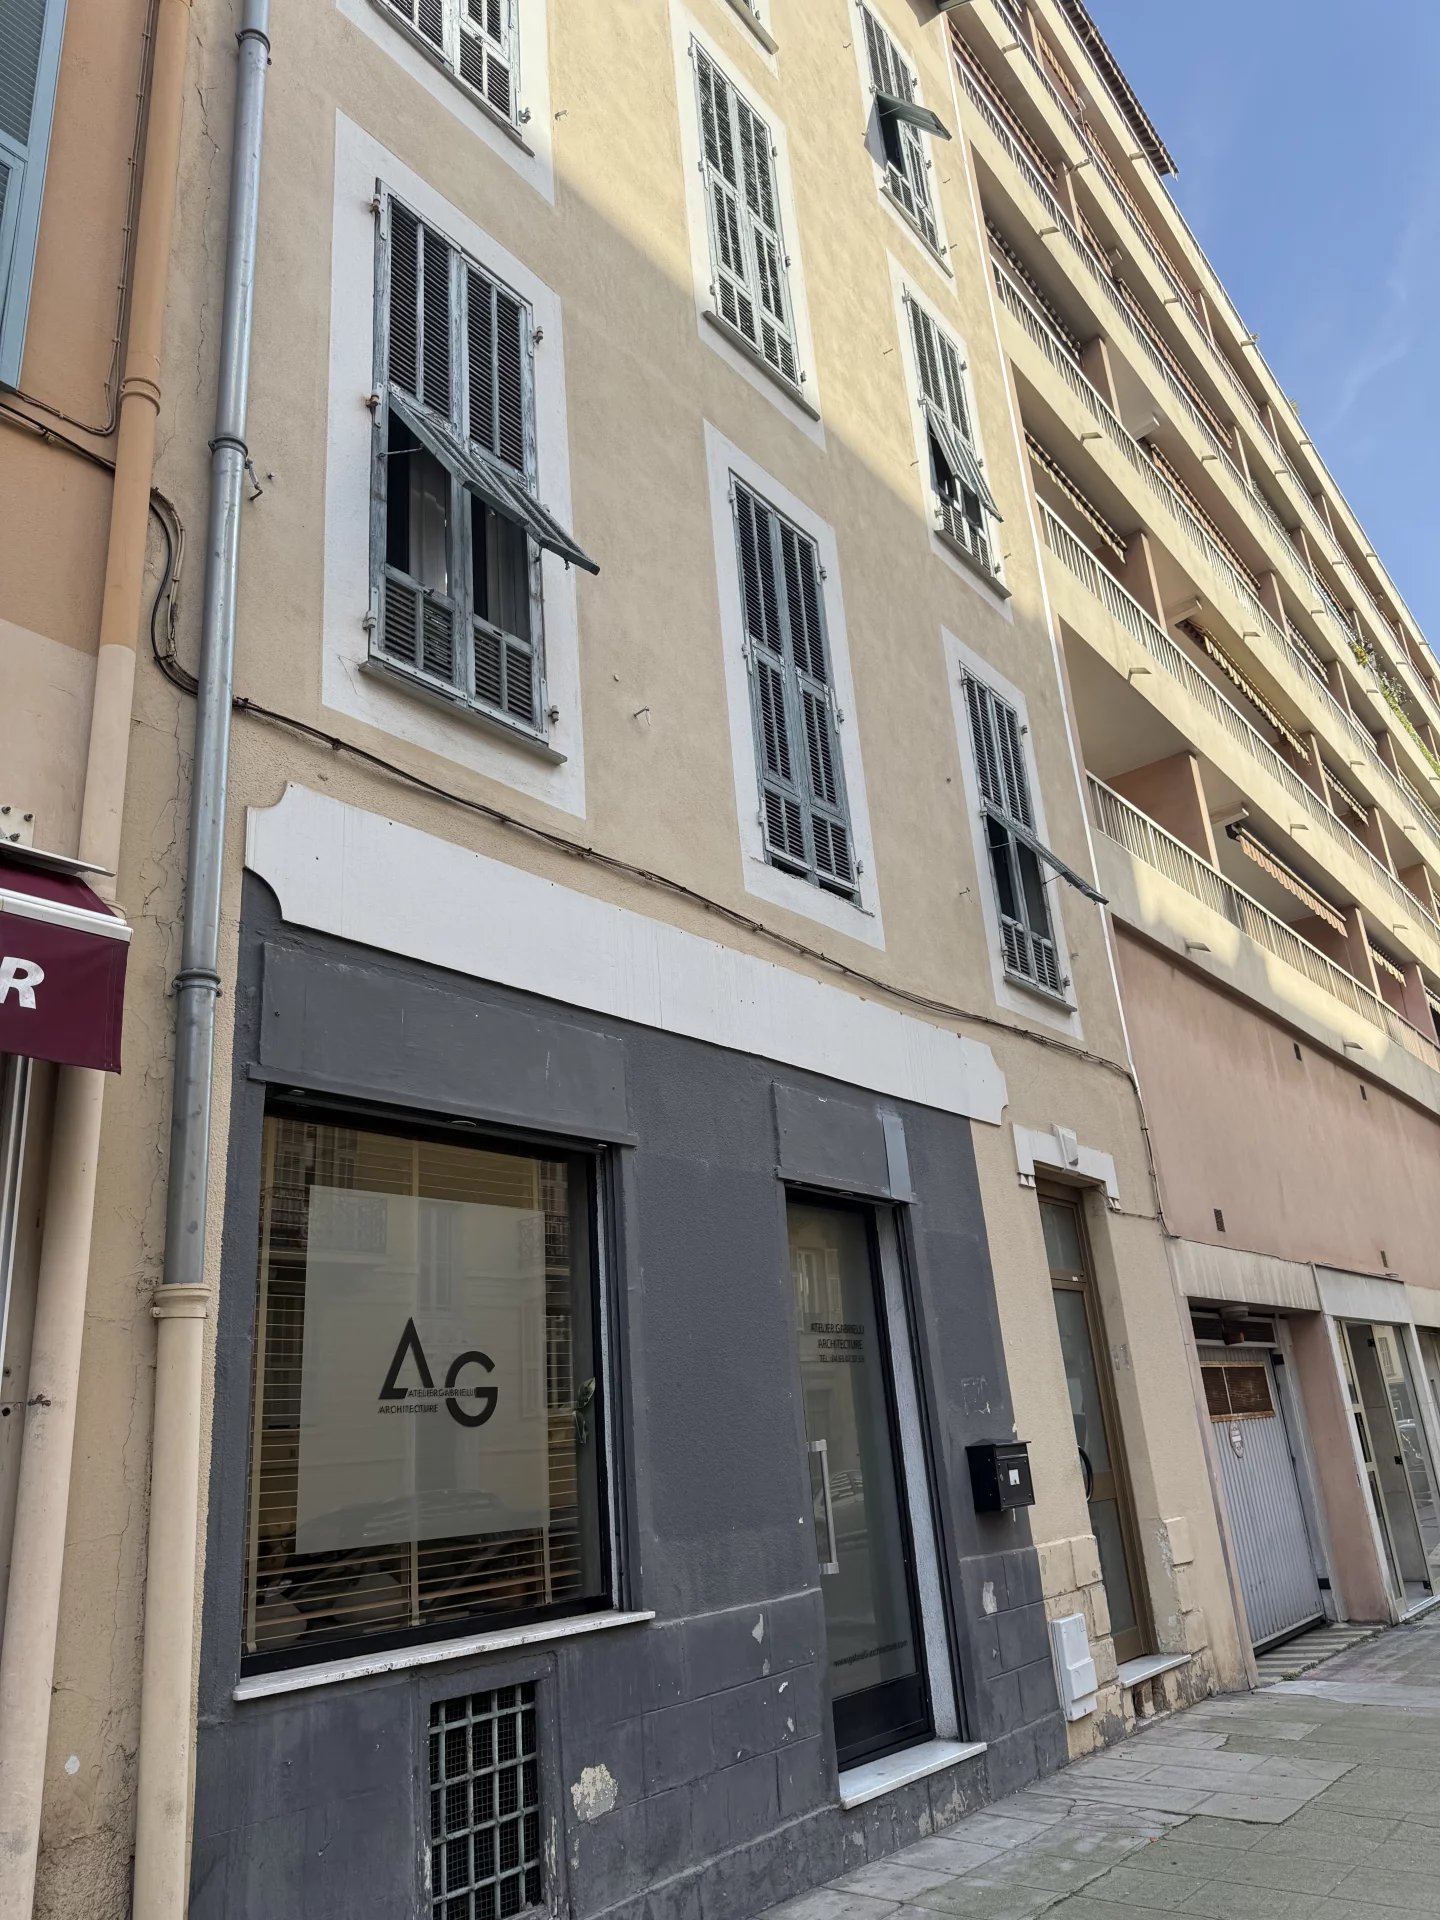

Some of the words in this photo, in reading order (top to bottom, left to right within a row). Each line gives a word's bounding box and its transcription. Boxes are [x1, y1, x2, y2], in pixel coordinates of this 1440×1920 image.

[0, 956, 45, 1010] R
[818, 1339, 863, 1349] ARCHITECTURE
[378, 1404, 439, 1414] ARCHITECTURE
